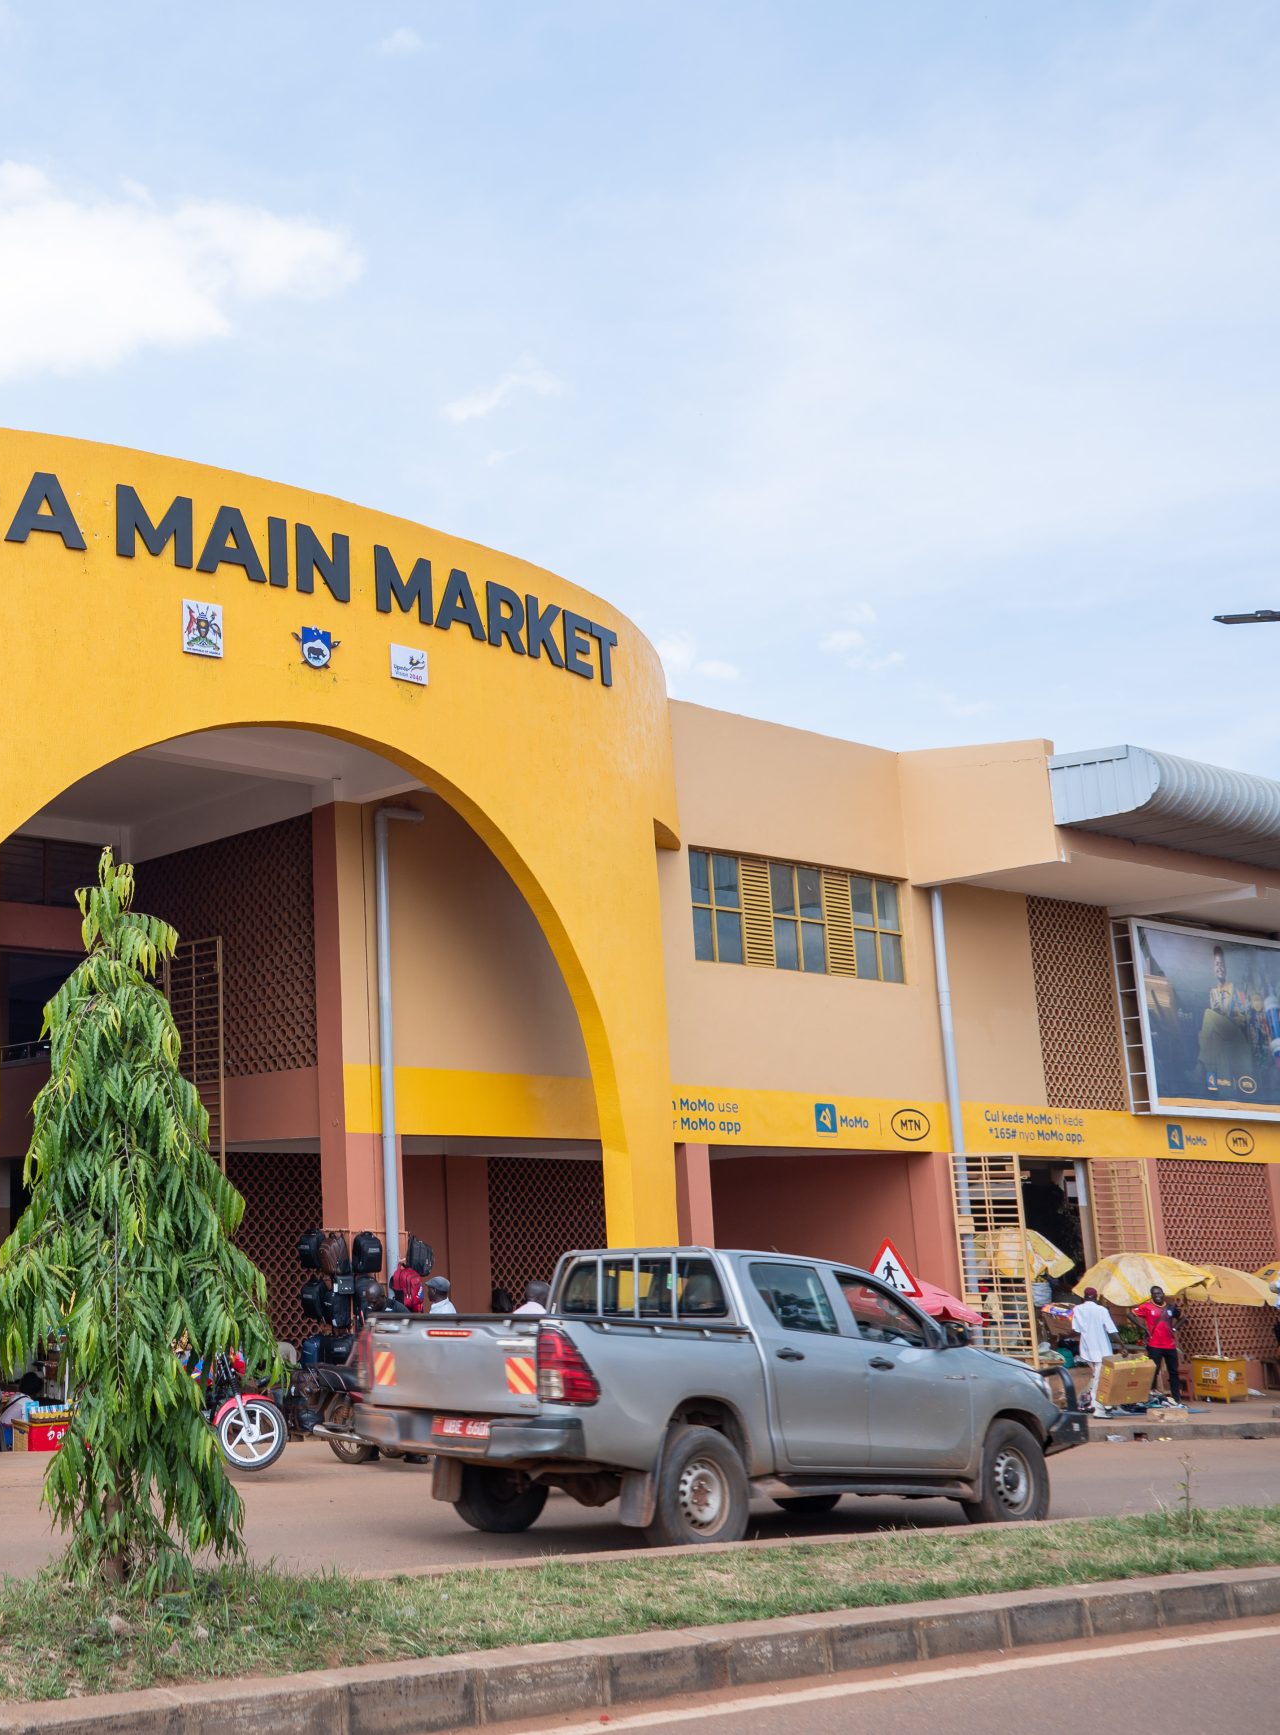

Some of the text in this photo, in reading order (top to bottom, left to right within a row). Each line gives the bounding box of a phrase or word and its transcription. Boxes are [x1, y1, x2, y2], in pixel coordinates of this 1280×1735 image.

[116, 483, 350, 603] MAIN
[374, 544, 618, 687] MARKET
[410, 673, 422, 681] 2040
[680, 1098, 715, 1112] MoMo
[718, 1102, 739, 1113] use
[840, 1115, 869, 1129] MoMo
[900, 1119, 921, 1131] MTN
[984, 1110, 1000, 1122] Cul
[1002, 1111, 1024, 1124] kede
[1026, 1113, 1053, 1125] MoMo
[1063, 1114, 1084, 1127] kede
[681, 1117, 716, 1131] MoMo
[719, 1121, 741, 1135] app
[1019, 1130, 1035, 1142] nyo
[1037, 1130, 1064, 1142] MoMo
[1066, 1132, 1085, 1145] app.
[1185, 1135, 1207, 1146] MoMo
[1232, 1137, 1248, 1147] MTN
